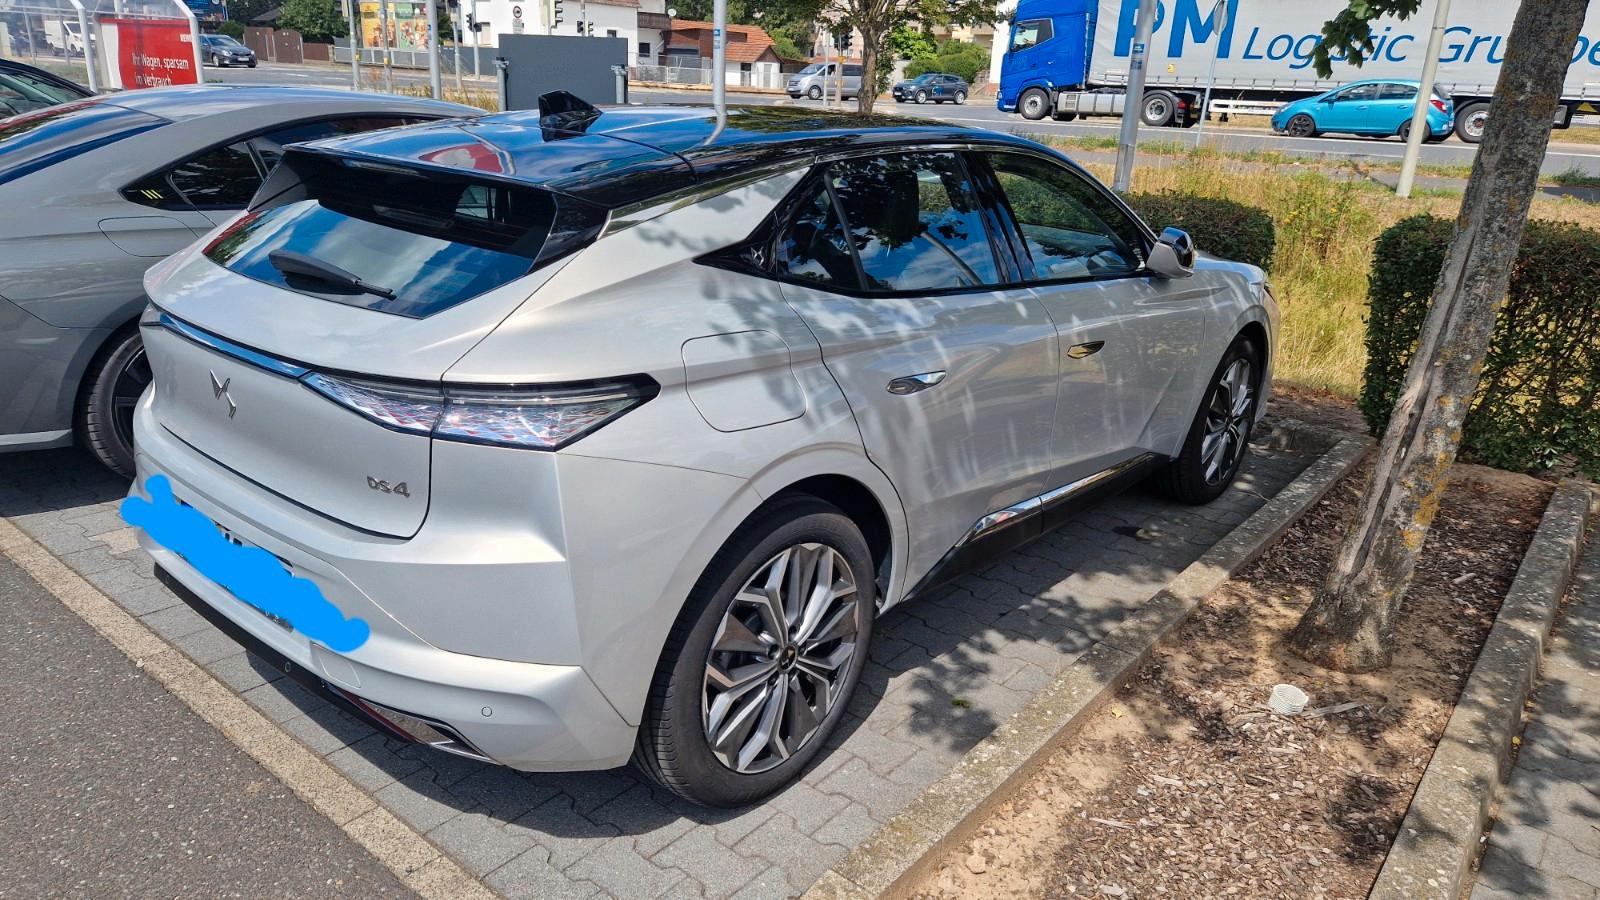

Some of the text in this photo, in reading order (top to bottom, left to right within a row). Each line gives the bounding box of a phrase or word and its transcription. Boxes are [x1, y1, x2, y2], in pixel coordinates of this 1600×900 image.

[1114, 0, 1238, 58] PM
[1242, 27, 1415, 69] Logtic
[142, 54, 163, 71] Wagen,
[163, 57, 189, 71] sparsam
